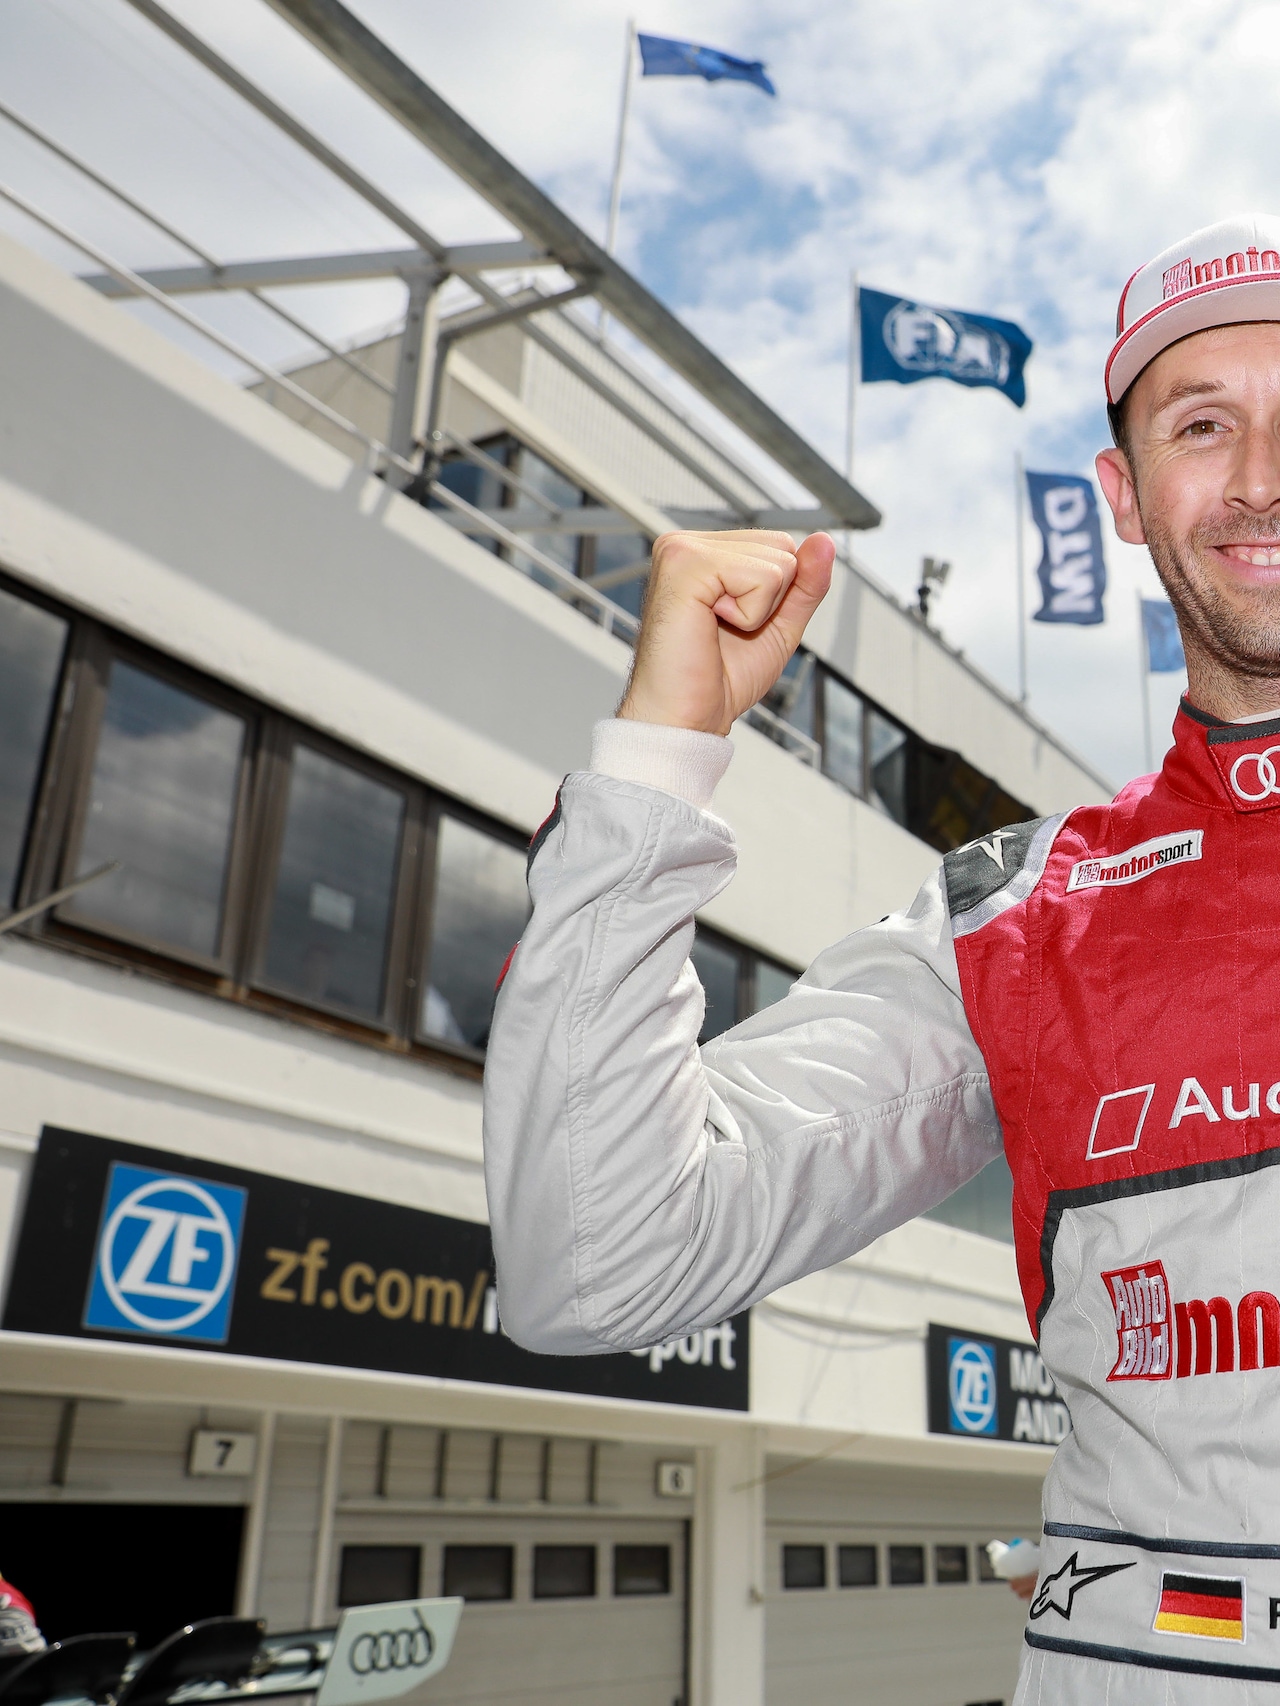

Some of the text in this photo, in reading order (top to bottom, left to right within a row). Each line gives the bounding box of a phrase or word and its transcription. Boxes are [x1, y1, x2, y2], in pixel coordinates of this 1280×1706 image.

[893, 309, 992, 372] FIA
[1100, 840, 1193, 881] motorsport
[1111, 1268, 1165, 1325] Auto
[1009, 1347, 1062, 1399] MO
[1117, 1324, 1168, 1377] Bild
[1013, 1397, 1071, 1444] AND
[215, 1440, 233, 1465] 7
[669, 1470, 683, 1491] 6
